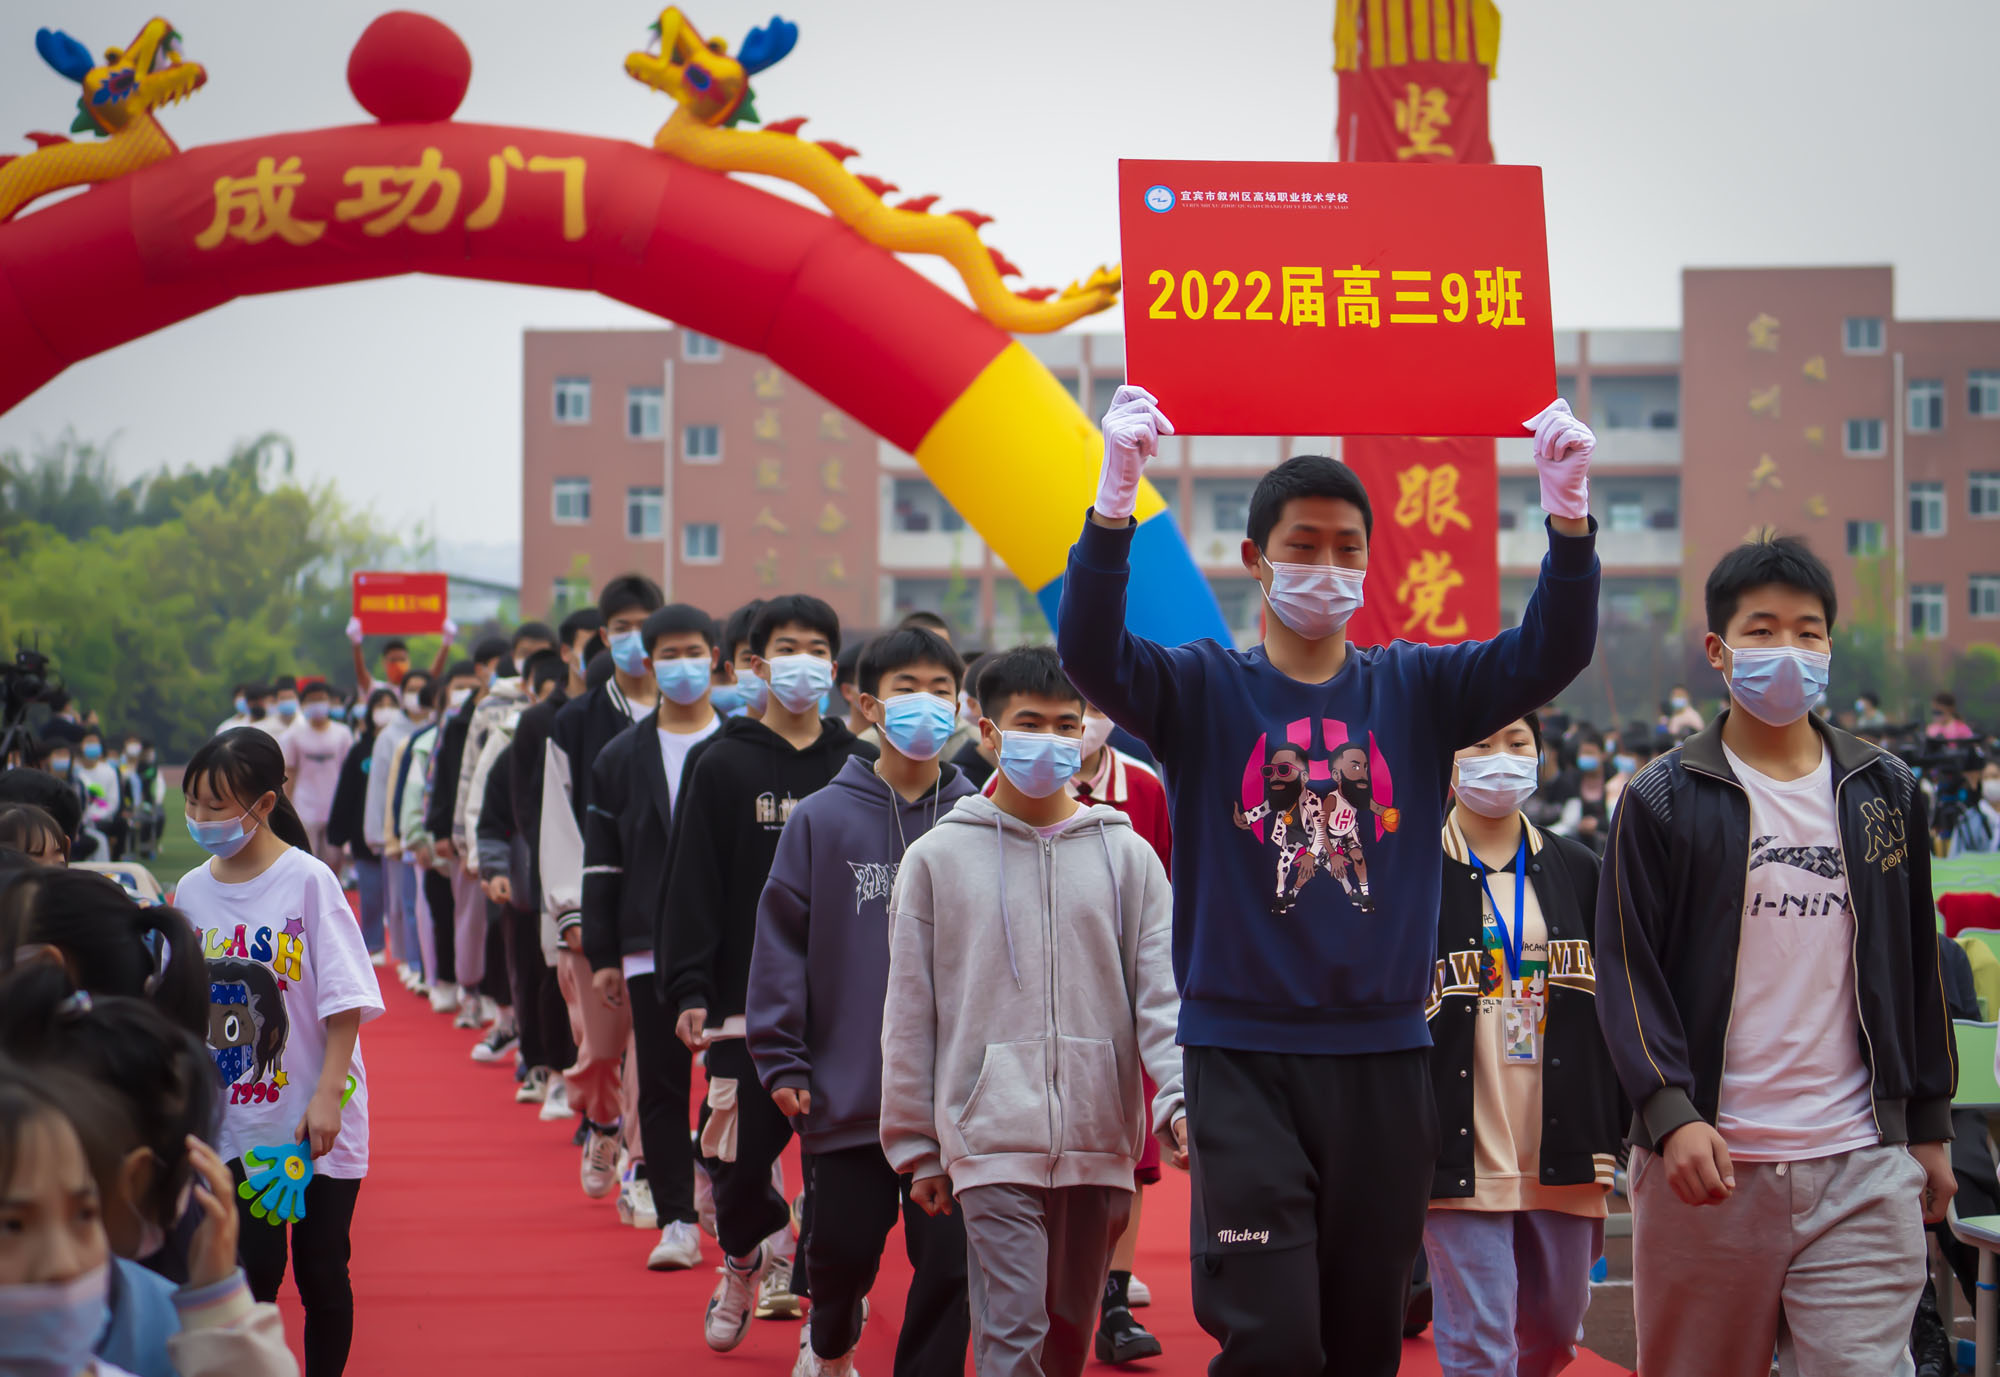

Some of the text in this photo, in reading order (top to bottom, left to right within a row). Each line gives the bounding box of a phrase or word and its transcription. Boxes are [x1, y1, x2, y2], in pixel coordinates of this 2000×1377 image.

[1395, 81, 1454, 160] 坚
[195, 145, 587, 250] 成功门
[1180, 190, 1349, 204] 宜宾市叙州区高场职业技术学校
[1148, 265, 1526, 329] 2022届高三9班
[1394, 463, 1472, 638] 跟党
[1745, 892, 1852, 917] I-NIN
[197, 924, 304, 981] LASH
[229, 1082, 280, 1105] 1996
[1217, 1228, 1270, 1244] Mickey
